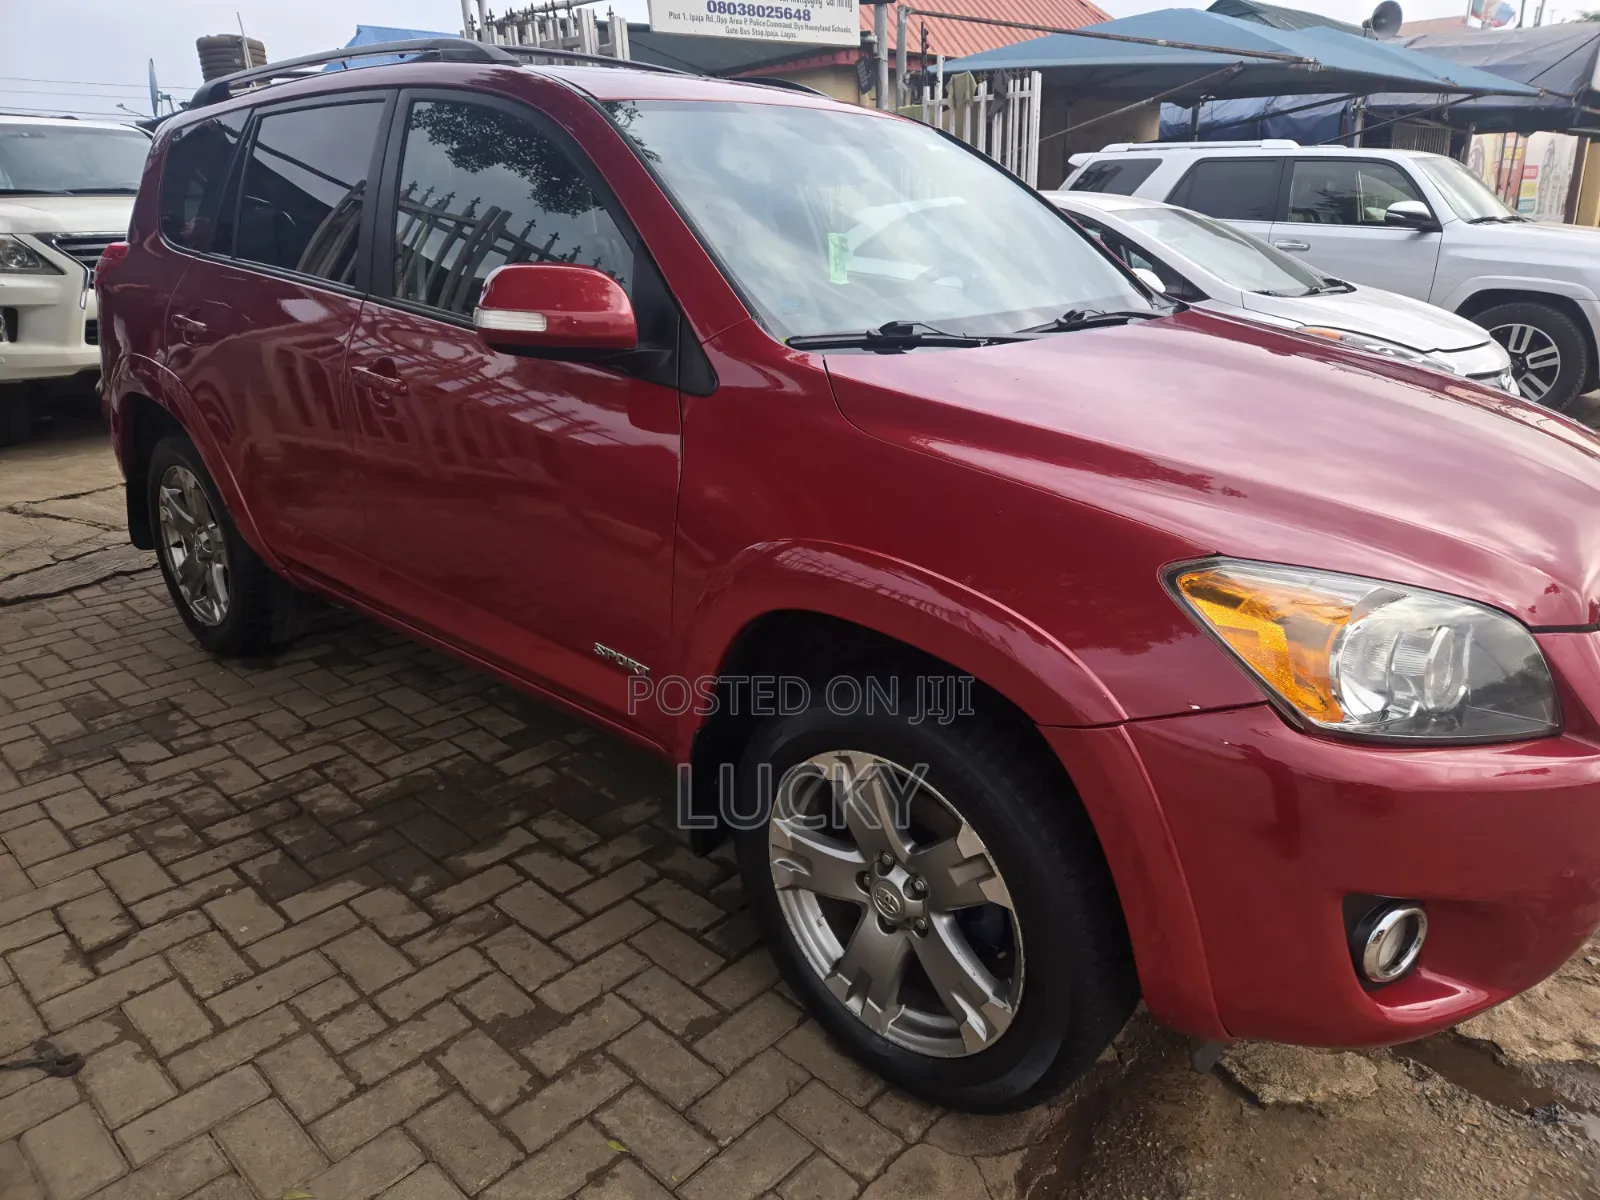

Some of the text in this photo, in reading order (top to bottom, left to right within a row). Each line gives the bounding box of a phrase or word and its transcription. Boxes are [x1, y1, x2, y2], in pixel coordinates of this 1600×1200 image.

[668, 11, 681, 20] Plot
[689, 13, 704, 23] Ipaja
[729, 17, 743, 25] Area
[749, 18, 766, 27] Police
[707, 0, 811, 21] 08038025648
[739, 27, 751, 35] Bus
[593, 642, 650, 677] SPORT
